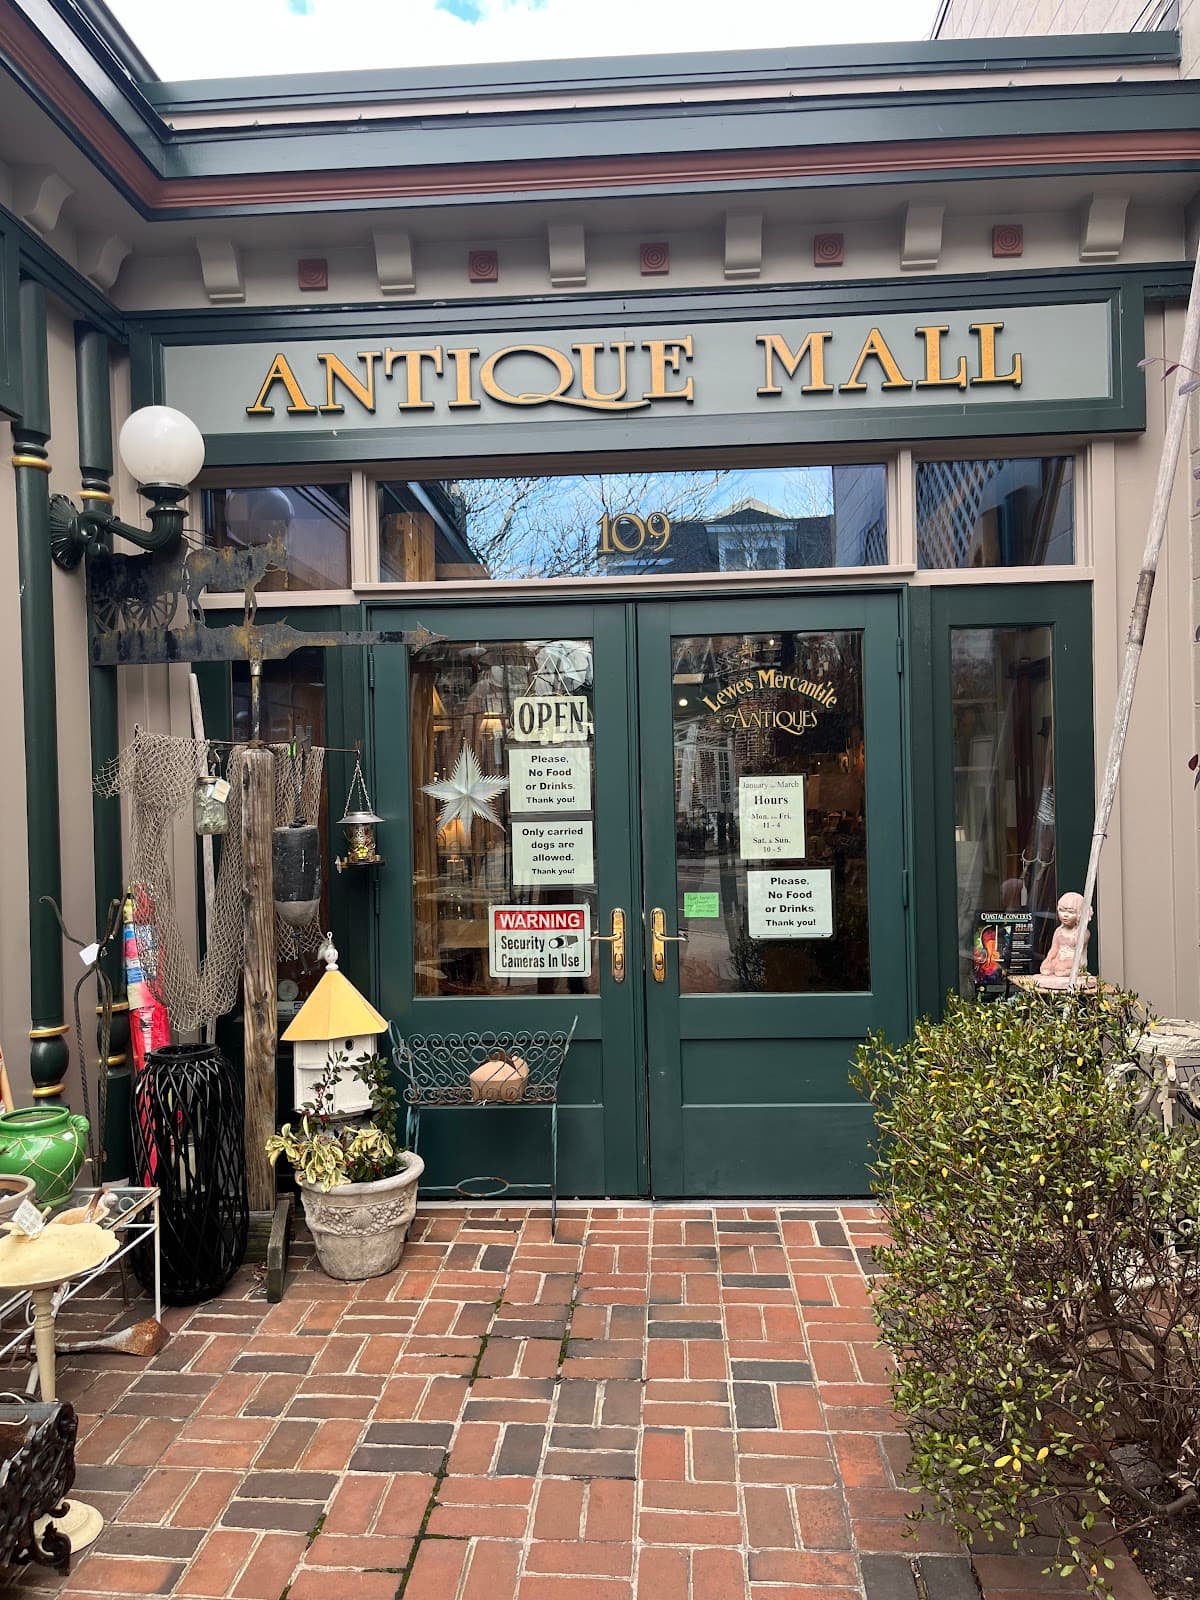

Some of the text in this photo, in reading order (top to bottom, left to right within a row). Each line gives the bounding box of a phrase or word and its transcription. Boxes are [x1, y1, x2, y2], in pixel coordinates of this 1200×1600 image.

[245, 321, 1023, 416] ANTIQUE MALL
[596, 512, 670, 554] 109
[702, 668, 838, 712] Lewes Mercantile
[519, 702, 584, 735] OPEN
[724, 708, 818, 735] ANTIQUES
[754, 796, 788, 805] Hours
[522, 828, 544, 837] Only
[531, 842, 555, 850] dogs
[499, 913, 580, 928] WARNING
[797, 919, 816, 927] you!
[501, 936, 545, 952] Security
[502, 953, 579, 968] Cameras In Use
